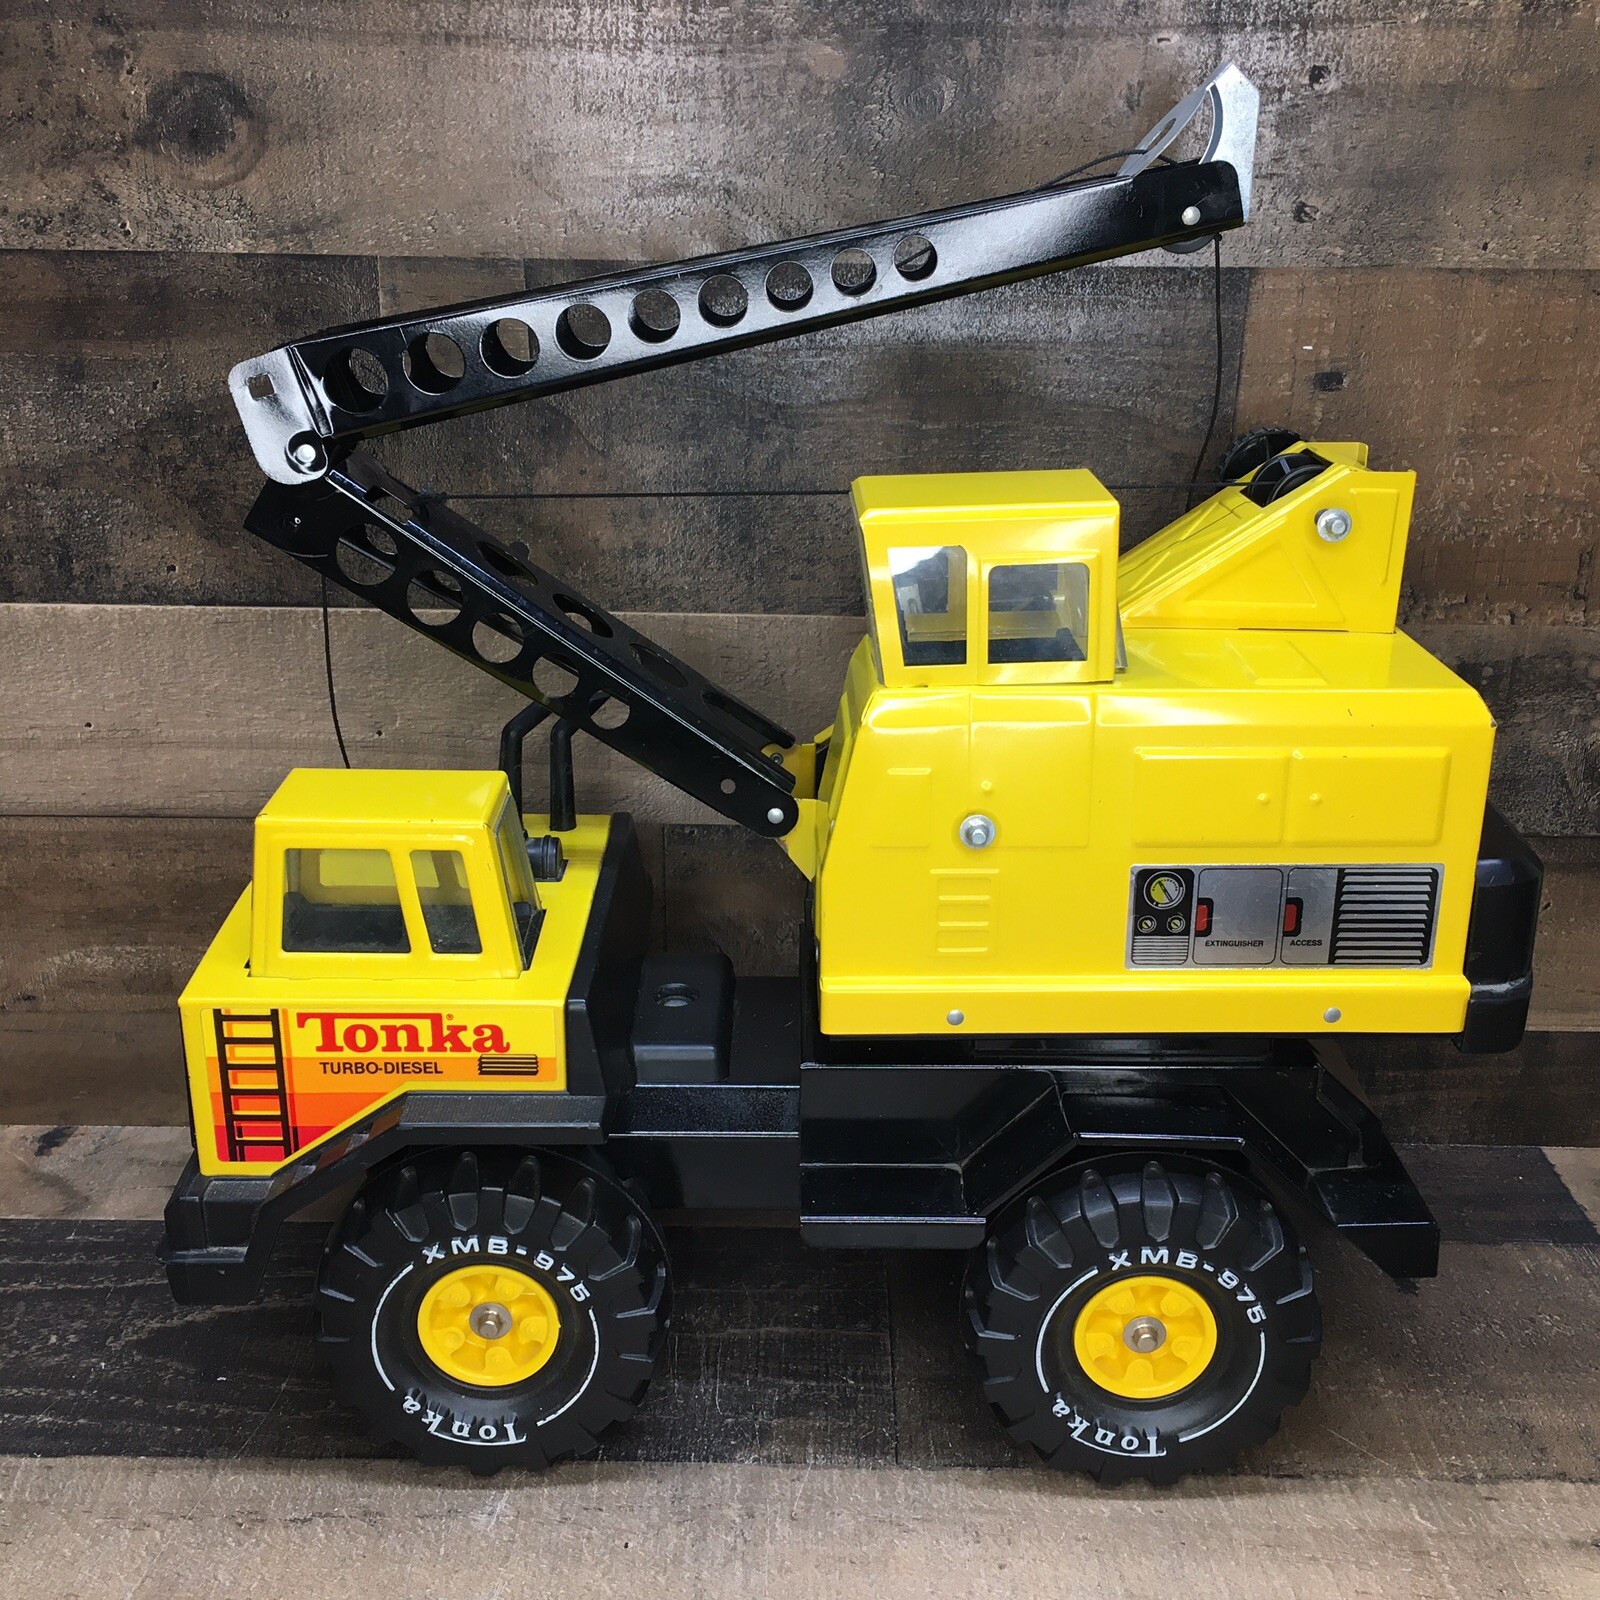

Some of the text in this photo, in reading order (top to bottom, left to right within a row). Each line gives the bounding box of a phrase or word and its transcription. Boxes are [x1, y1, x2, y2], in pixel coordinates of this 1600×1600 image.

[1205, 939, 1264, 948] EXTINGUISHER
[1289, 939, 1323, 947] ACCESS
[297, 1012, 510, 1053] Tonka
[318, 1061, 443, 1075] TURBO-DIESEL
[422, 1235, 590, 1302] XMB-975
[1108, 1246, 1267, 1324] XMB-975
[402, 1395, 526, 1446] Tonka
[1052, 1398, 1167, 1457] Tonka
